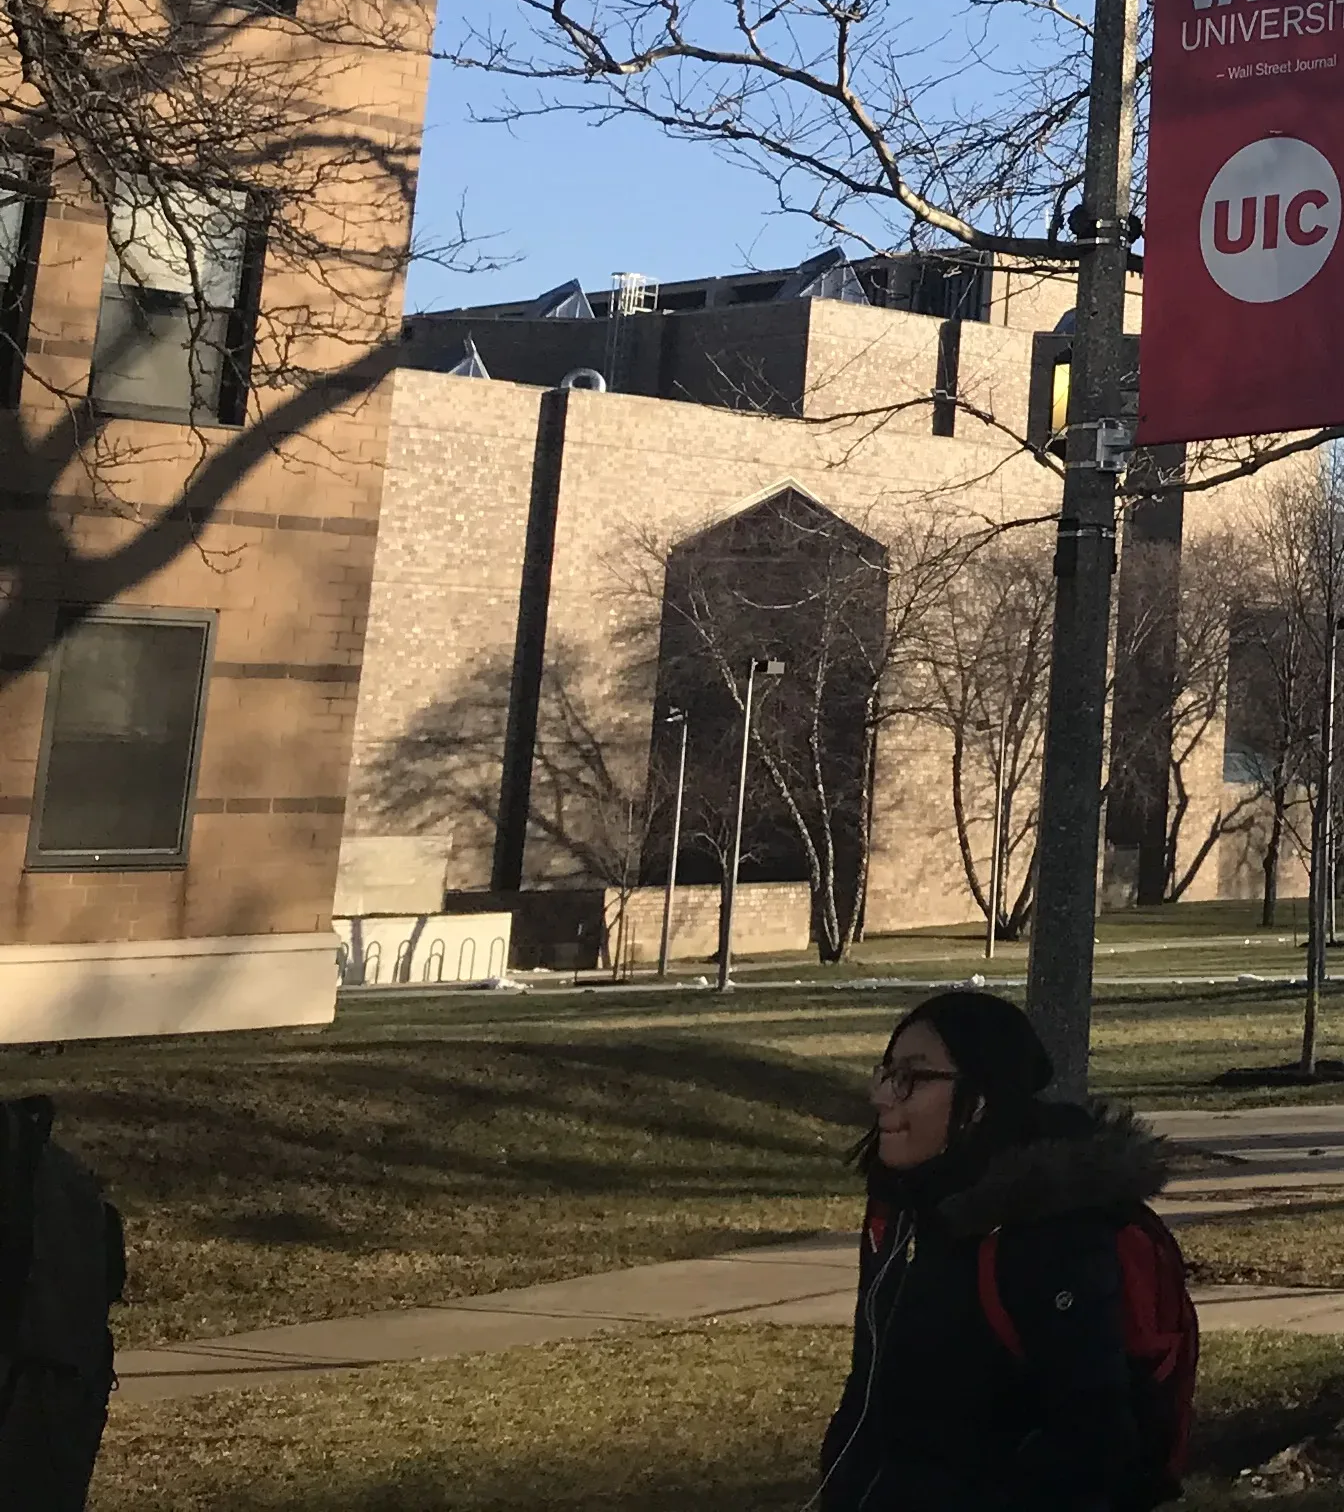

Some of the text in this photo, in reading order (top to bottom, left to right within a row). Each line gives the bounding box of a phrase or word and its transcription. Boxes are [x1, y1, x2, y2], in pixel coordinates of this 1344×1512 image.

[1227, 63, 1253, 80] Wall
[1255, 59, 1292, 77] Street
[1294, 53, 1337, 73] Journal
[1213, 188, 1331, 255] UIC
